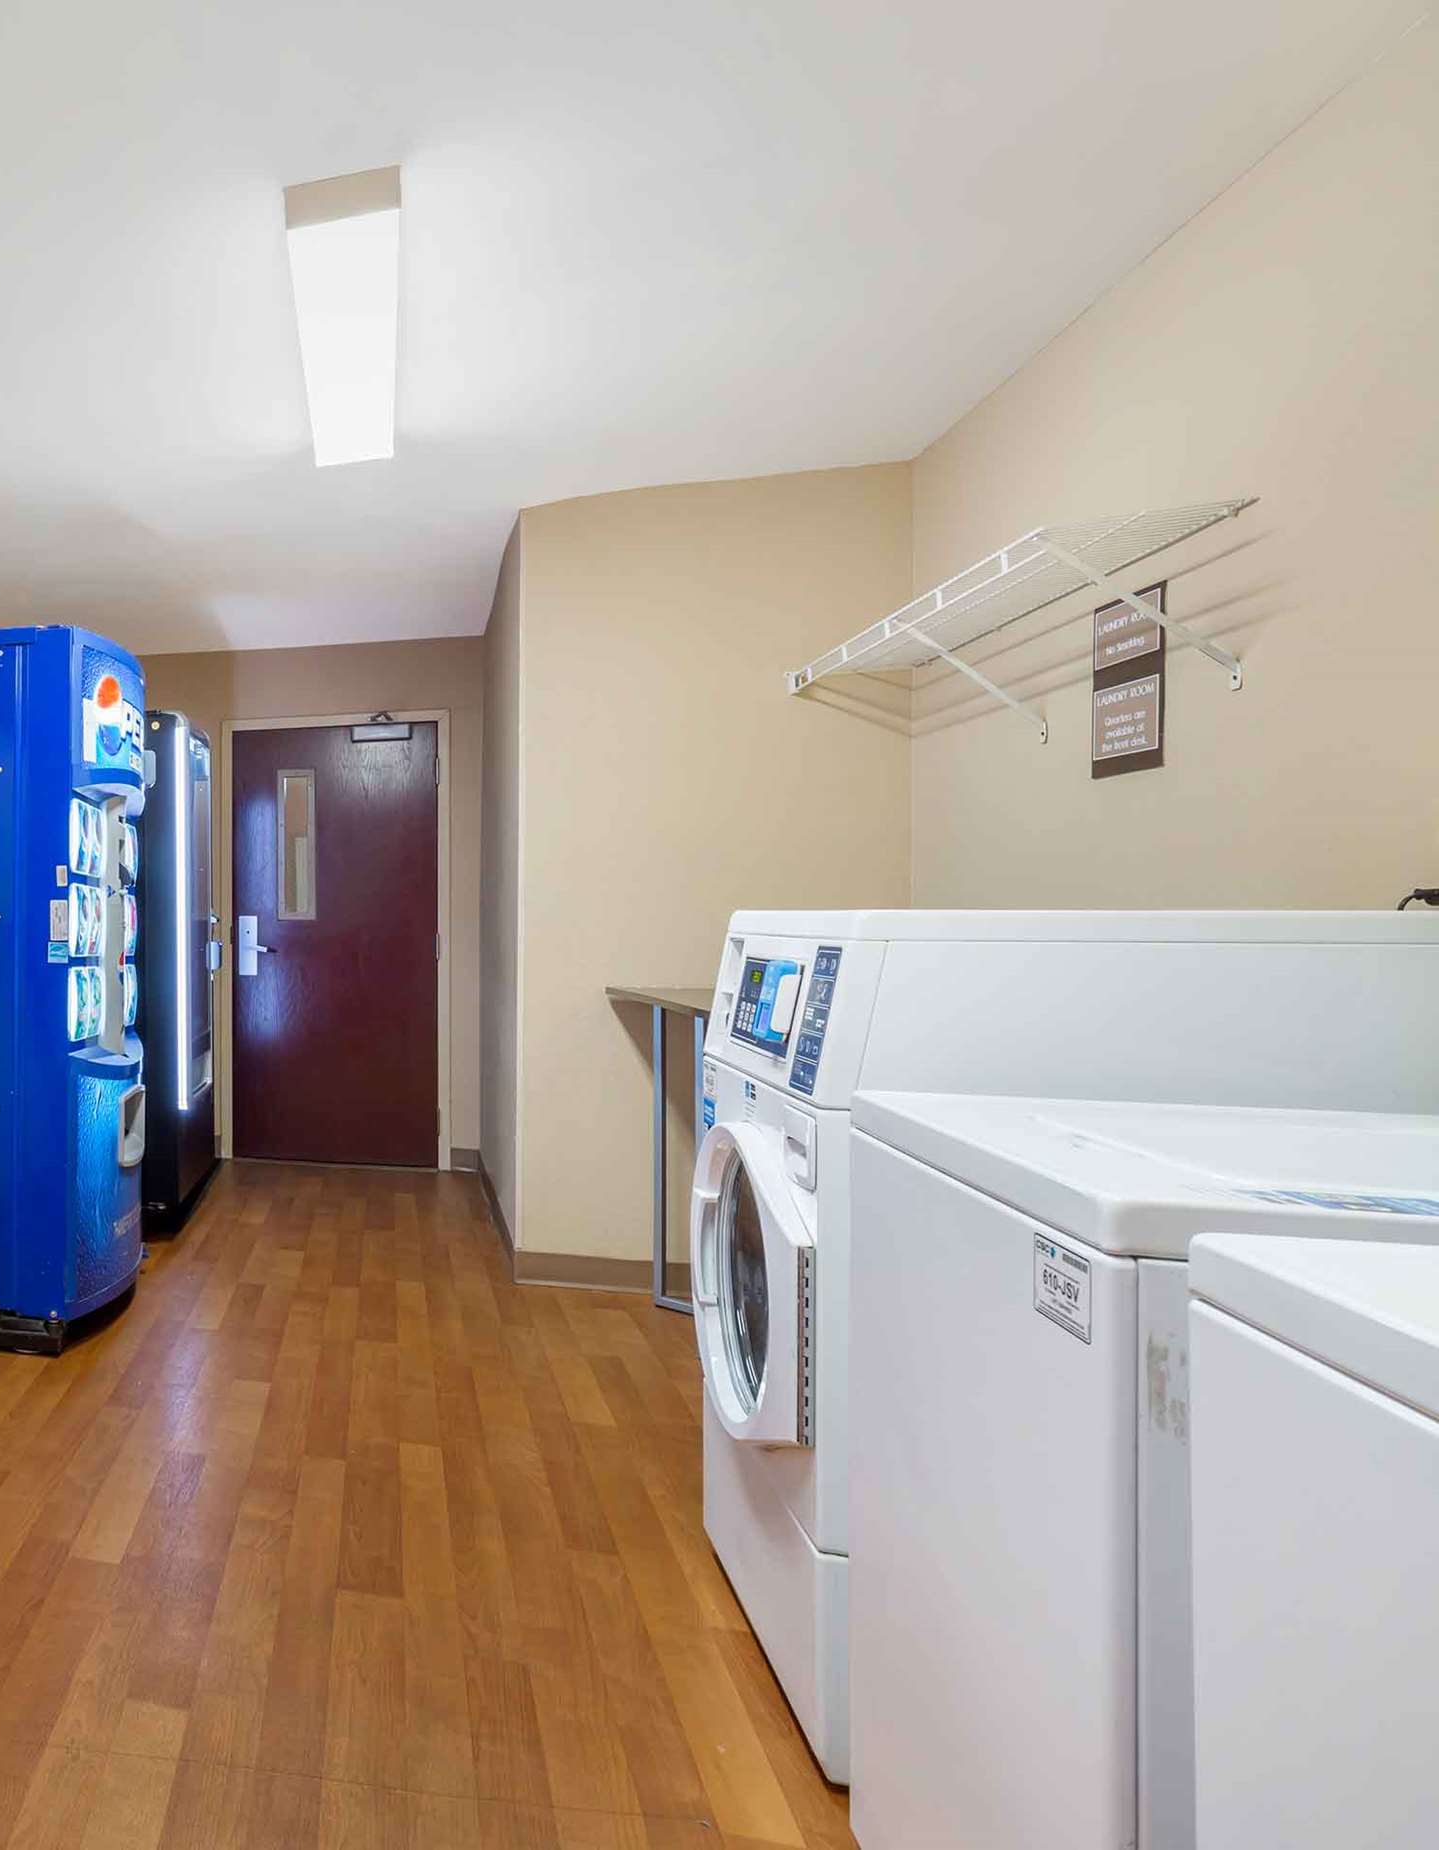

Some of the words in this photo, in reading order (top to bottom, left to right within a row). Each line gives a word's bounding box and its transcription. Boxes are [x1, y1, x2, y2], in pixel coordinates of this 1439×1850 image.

[1097, 613, 1129, 636] LAUNDRY
[1105, 643, 1116, 656] No
[1116, 635, 1145, 653] Smoking
[1096, 689, 1129, 708] LAUNDRY
[1130, 682, 1155, 699] ROOM
[1042, 1269, 1081, 1303] 610-JSV
